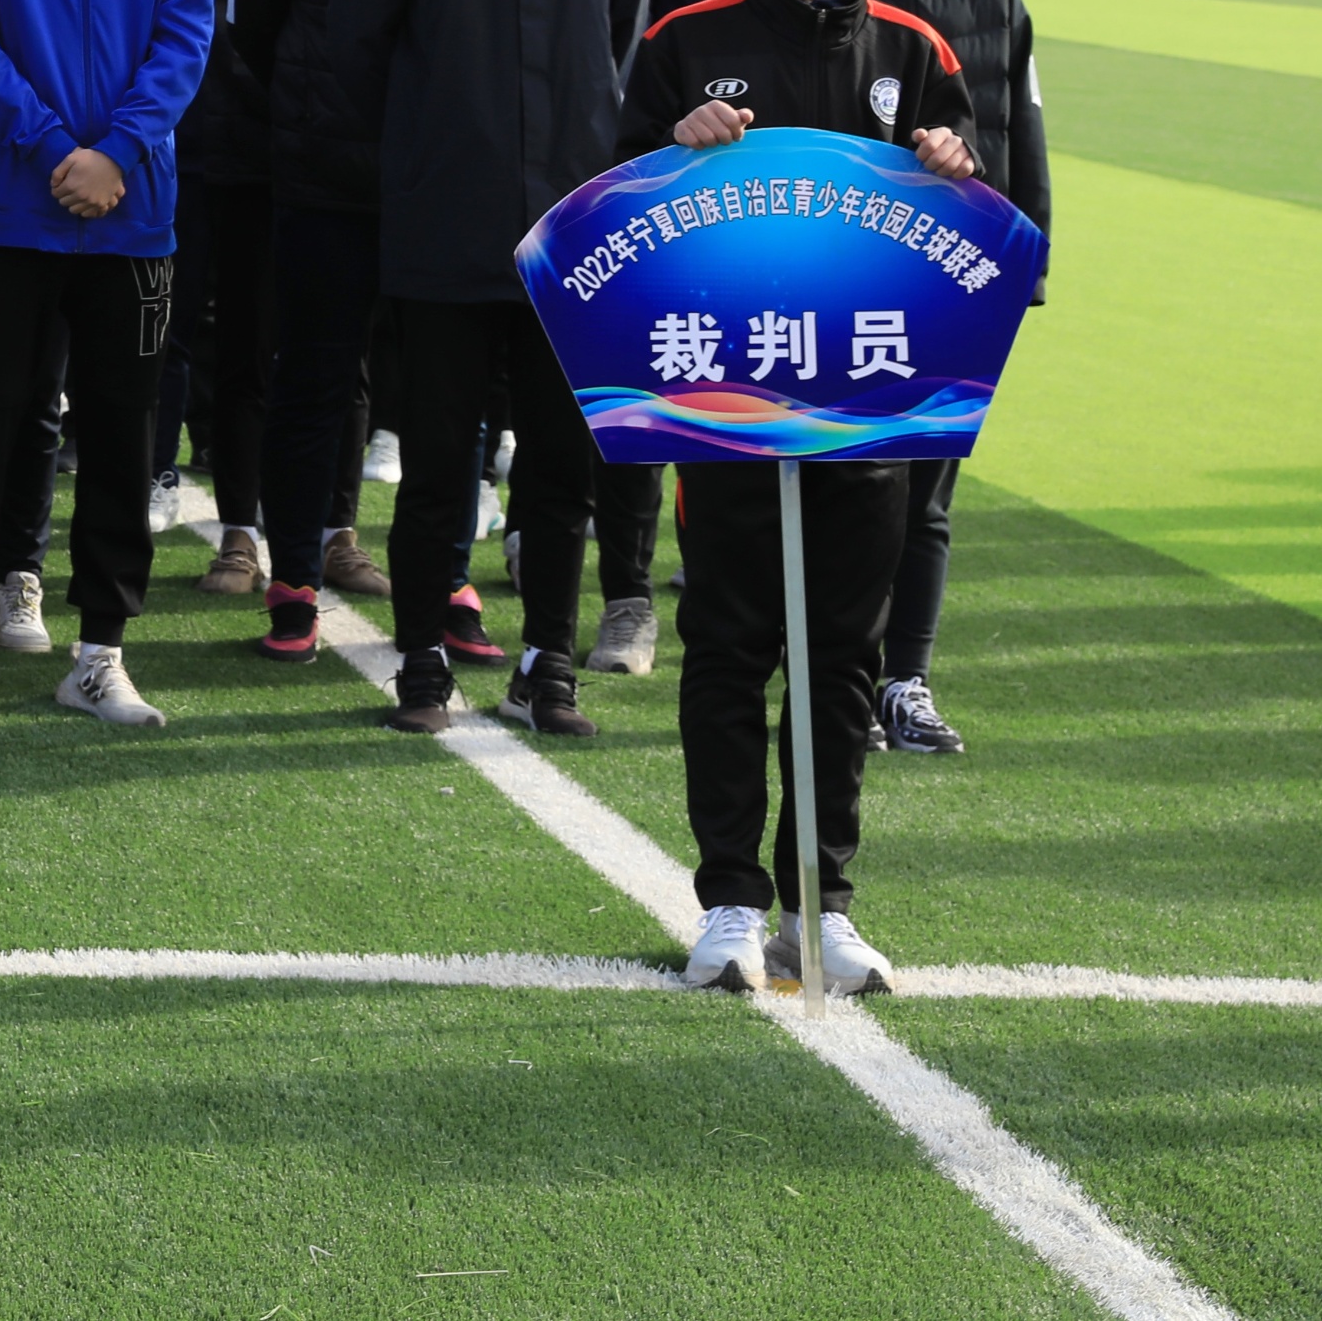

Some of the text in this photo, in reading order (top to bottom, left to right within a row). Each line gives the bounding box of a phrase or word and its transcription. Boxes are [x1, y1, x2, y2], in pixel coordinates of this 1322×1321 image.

[562, 176, 1001, 303] 2022年宁夏回族自治区青少年校园足球联赛
[649, 309, 917, 383] 裁判员
